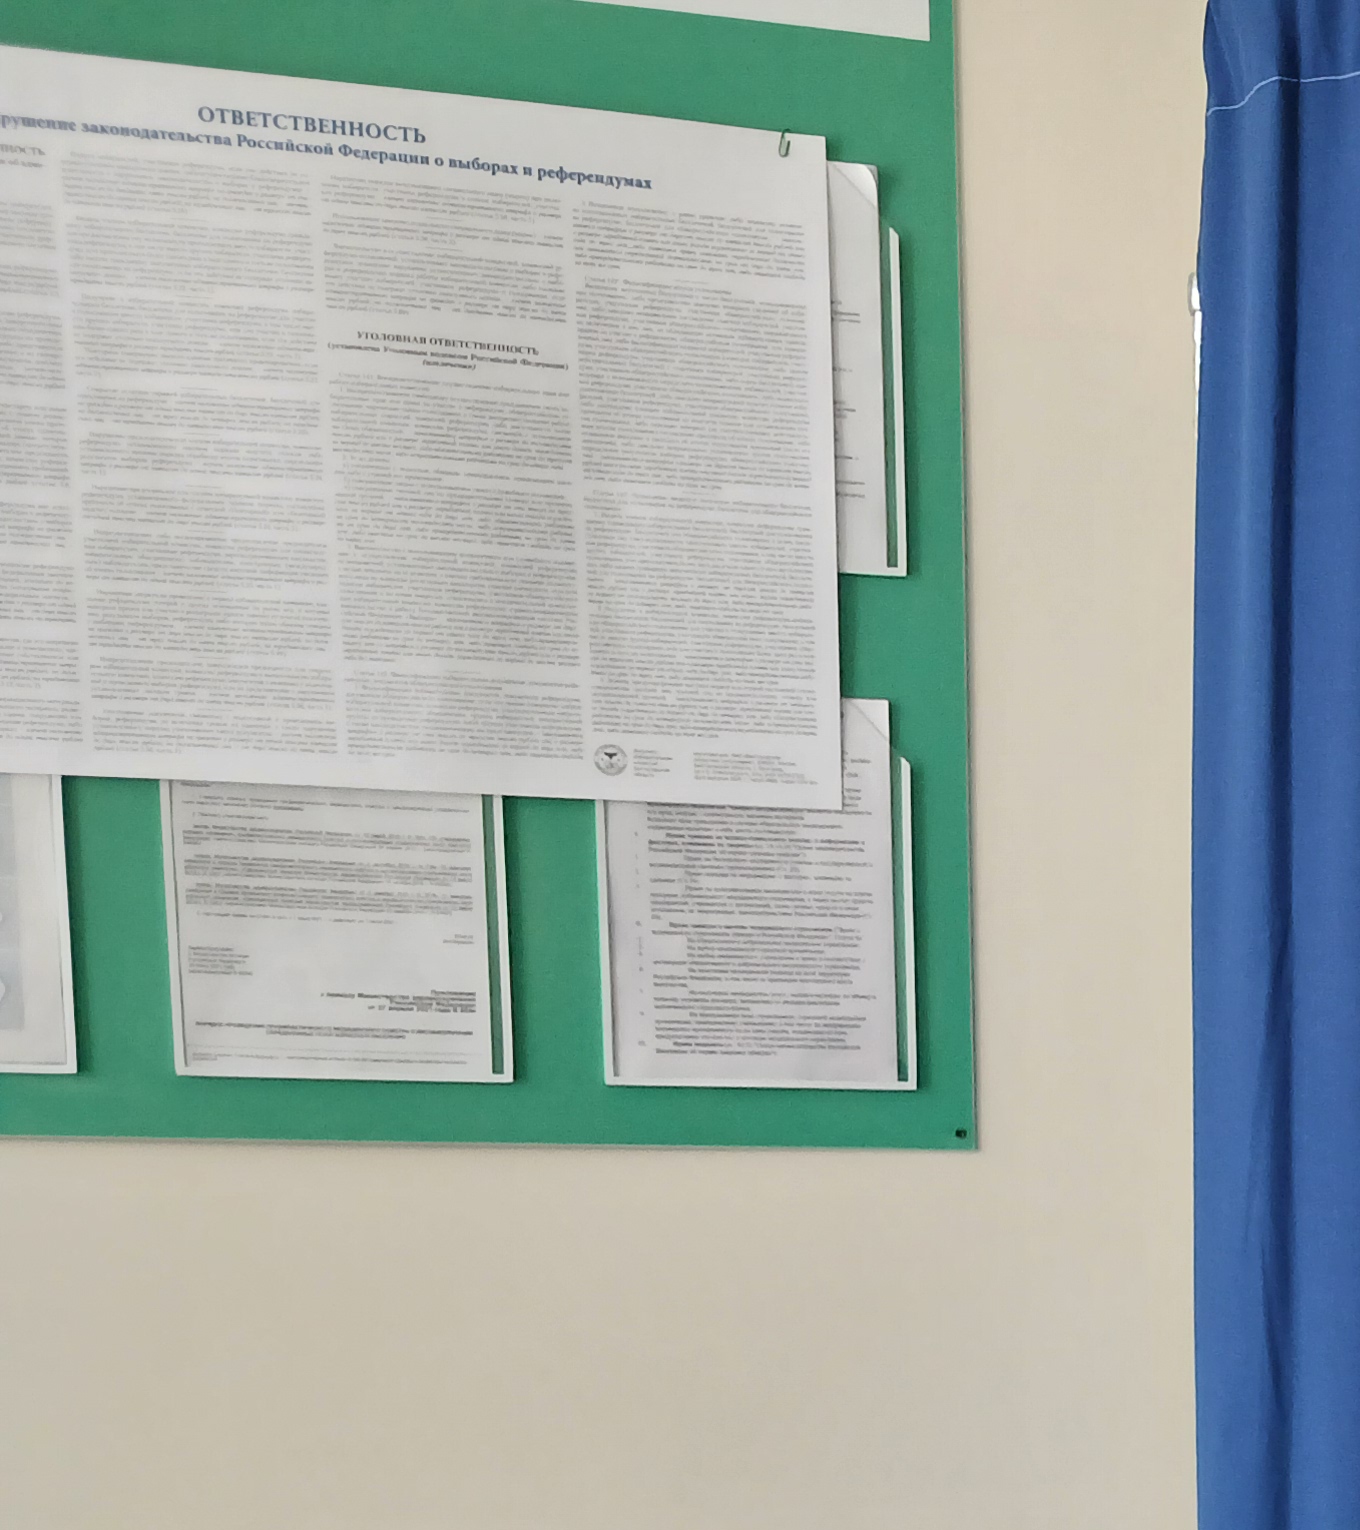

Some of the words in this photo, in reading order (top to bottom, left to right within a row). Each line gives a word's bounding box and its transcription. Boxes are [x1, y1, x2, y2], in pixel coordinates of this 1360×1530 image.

[197, 106, 427, 143] ОТВЕТСТВЕННОСТЬ
[81, 121, 232, 147] законодательства
[236, 133, 333, 156] Российской
[338, 143, 430, 164] Федерации
[434, 156, 444, 167] о
[448, 156, 518, 176] выборах
[522, 166, 533, 177] и
[537, 165, 653, 190] референдумах
[357, 331, 427, 345] УГОЛОВНАЯ
[429, 337, 539, 355] ОТВЕТСТВЕННОСТЬ
